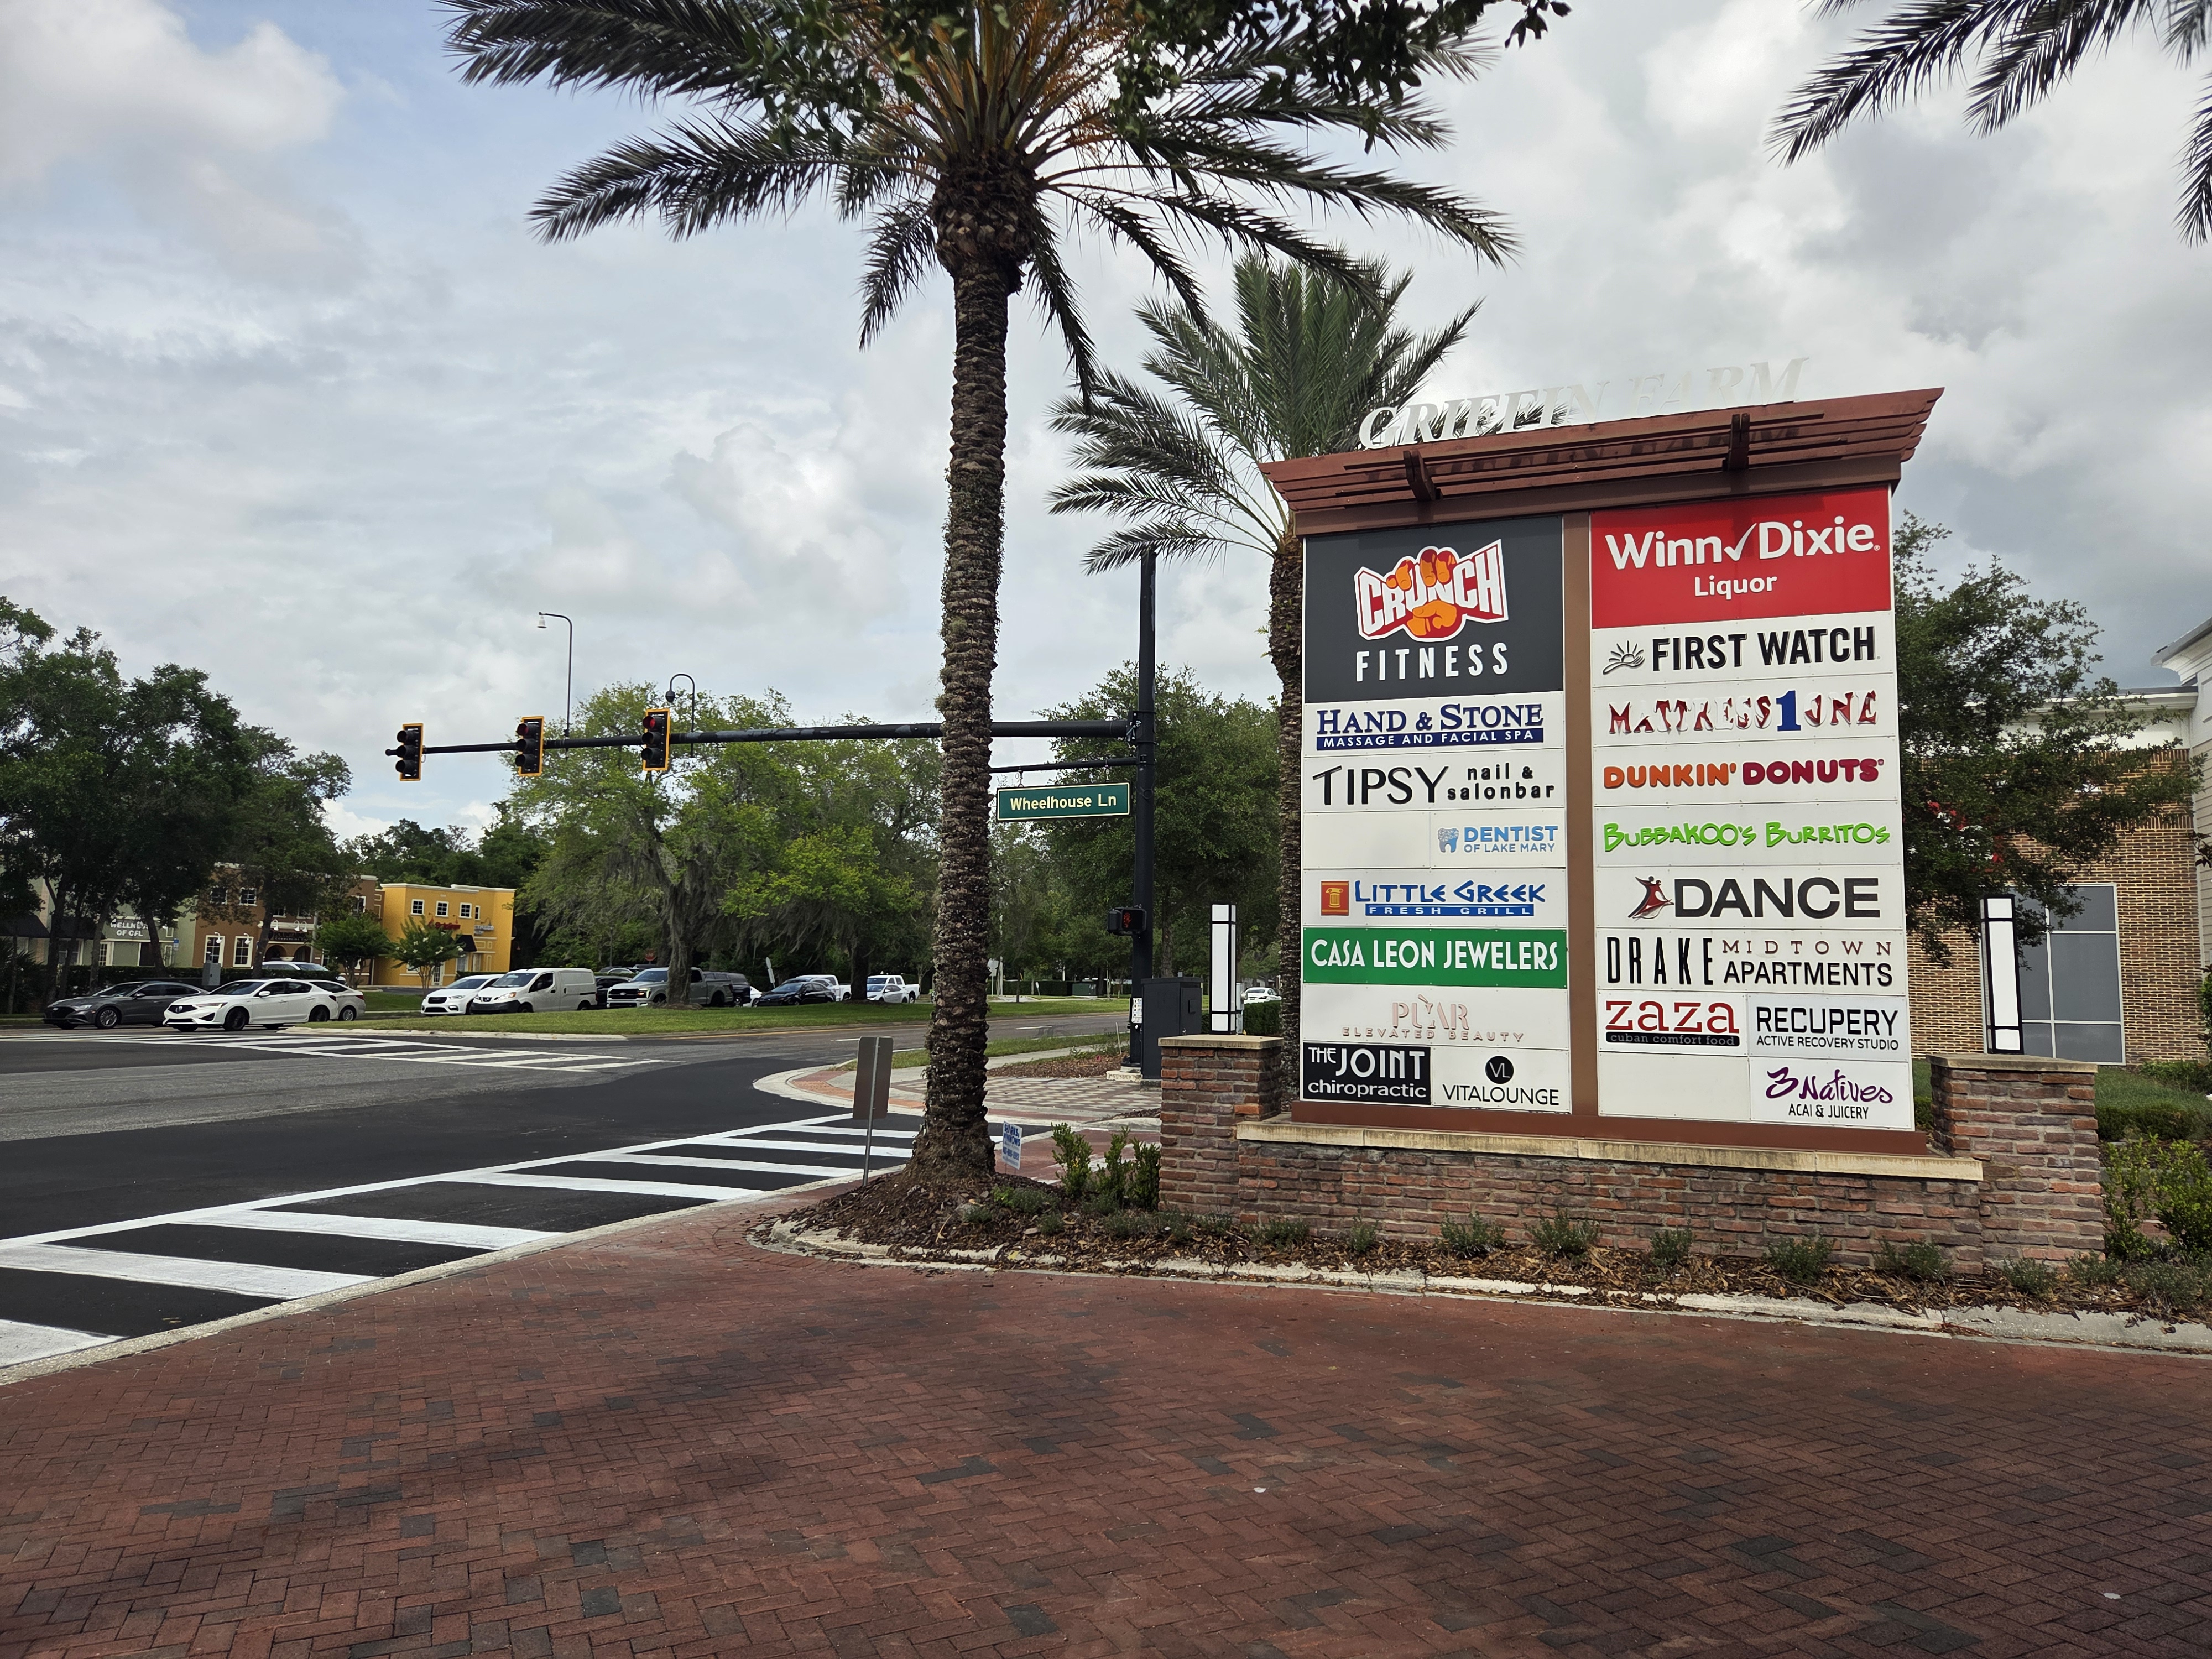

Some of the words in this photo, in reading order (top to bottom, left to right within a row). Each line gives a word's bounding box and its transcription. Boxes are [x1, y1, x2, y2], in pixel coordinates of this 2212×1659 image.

[1359, 380, 1610, 450] GRIFFIN
[1628, 357, 1809, 415] FARM
[1605, 531, 1723, 570] Winn
[1759, 515, 1874, 559] Dixie
[1359, 545, 1503, 635] CRUNCH
[1694, 575, 1777, 600] Liquor
[1652, 633, 1747, 672] FIRST
[1757, 625, 1876, 666] WATCH
[1357, 643, 1508, 682] FITNESS
[1317, 709, 1407, 734] HAND
[1415, 712, 1433, 731] &
[1439, 703, 1544, 731] STONE
[1609, 695, 1771, 734] MATTRESS
[1323, 735, 1395, 748] MASSAGE
[1402, 734, 1433, 744] AND
[1442, 731, 1497, 743] FACIAL
[1505, 729, 1533, 740] SPA
[1467, 763, 1510, 780] nail
[1522, 766, 1533, 779] &
[1603, 763, 1737, 789] DUNKIN'
[1743, 758, 1879, 785] DONUTS
[1312, 765, 1449, 806] TIPSY
[1447, 782, 1554, 800] salonbar
[1010, 796, 1092, 811] Wheelhouse
[1098, 793, 1117, 807] Ln
[1464, 826, 1558, 842] DENTIST
[1464, 843, 1481, 853] OF
[1484, 843, 1516, 853] LAKE
[1520, 842, 1555, 852] MARY
[1354, 880, 1446, 903] LITTLE
[1453, 880, 1546, 903] GREEK
[1674, 877, 1880, 919] DANCE
[110, 921, 149, 930] WELLNE
[1311, 939, 1365, 967] CASA
[1373, 940, 1435, 968] LEON
[1443, 941, 1558, 971] JEWELERS
[1606, 937, 1714, 985] DRAKE
[1722, 940, 1892, 956] MIDTOWN
[1724, 961, 1893, 987] APARTMENTS
[1605, 1000, 1740, 1034] zaza
[1756, 1006, 1898, 1036] RECUPERY
[1342, 1027, 1435, 1039] ELEVATED
[1448, 1030, 1524, 1042] BEAUTY
[1610, 1033, 1650, 1044] cuban
[1653, 1034, 1704, 1045] comfort
[1705, 1035, 1735, 1046] food
[1756, 1035, 1794, 1047] ACTIVE
[1797, 1037, 1855, 1049] RECOVERY
[1858, 1039, 1899, 1051] STUDIO
[1308, 1047, 1337, 1064] THE
[1335, 1048, 1425, 1079] JOINT
[1308, 1079, 1427, 1098] chiropractic
[1443, 1084, 1559, 1105] VITALOUNGE
[1765, 1067, 1799, 1099] 3
[1798, 1069, 1893, 1104] Natives
[1788, 1103, 1813, 1117] ACAI
[1815, 1104, 1824, 1118] &
[1828, 1105, 1869, 1120] JUICERY
